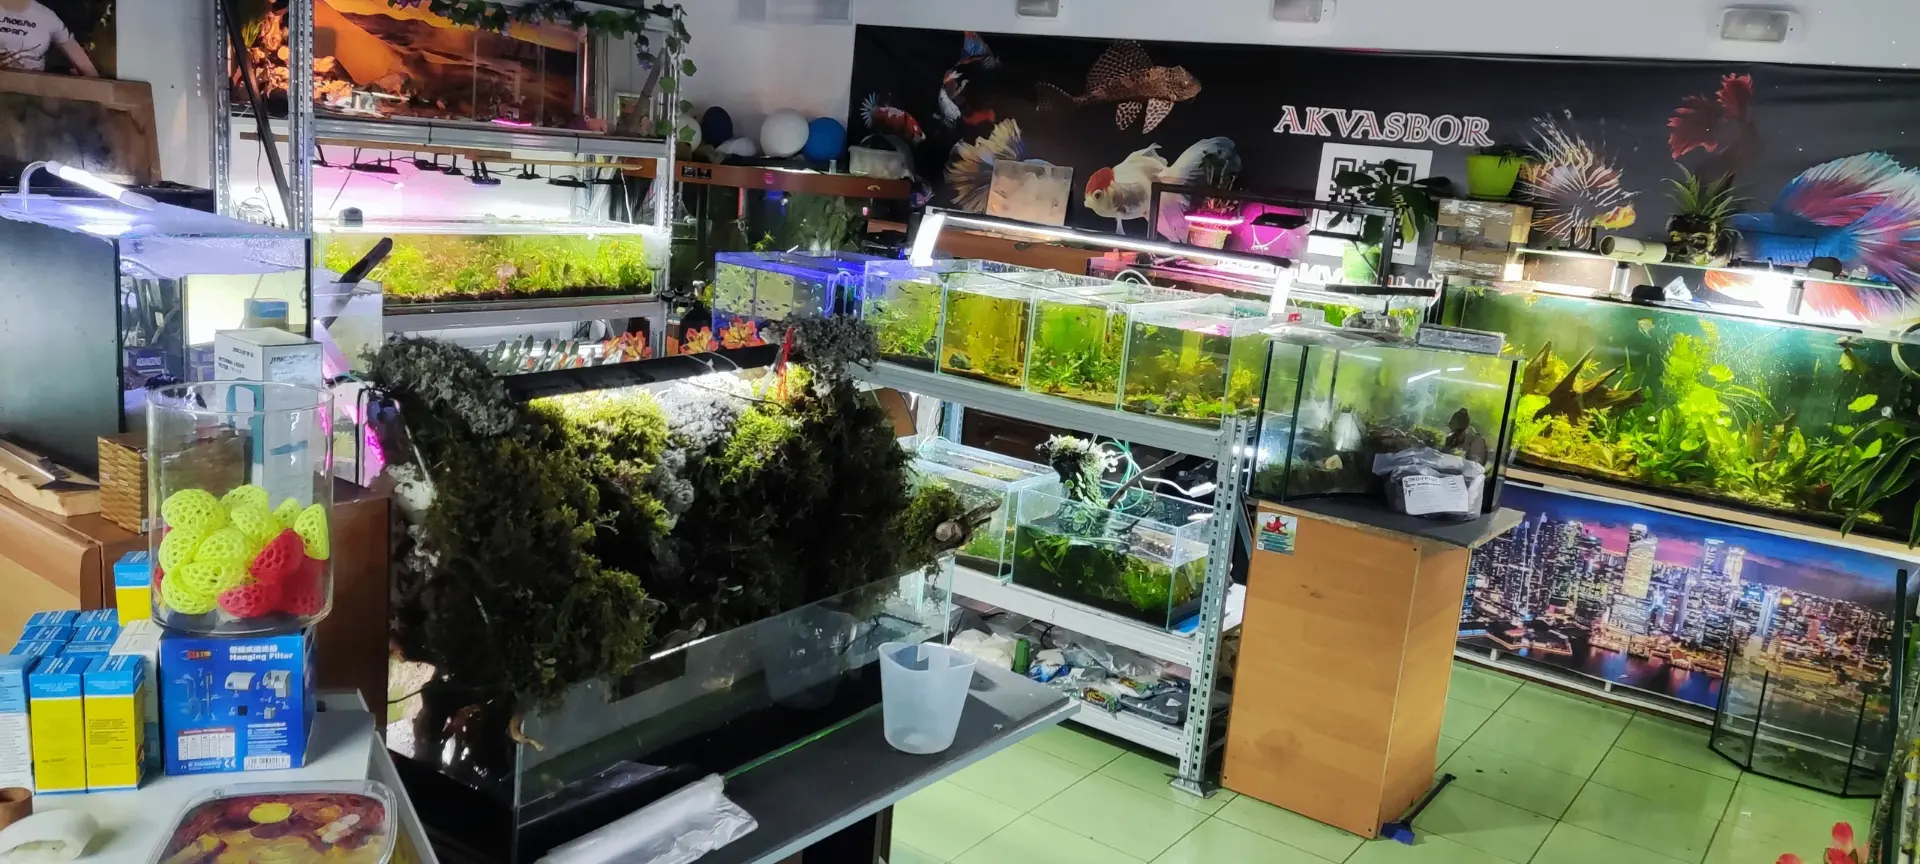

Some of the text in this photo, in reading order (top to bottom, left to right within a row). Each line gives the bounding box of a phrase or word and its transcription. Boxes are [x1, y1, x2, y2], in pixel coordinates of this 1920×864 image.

[0, 27, 28, 36] ОРЯГУ
[1273, 105, 1495, 146] AKVASBOR
[229, 652, 293, 661] Hanging Filter
